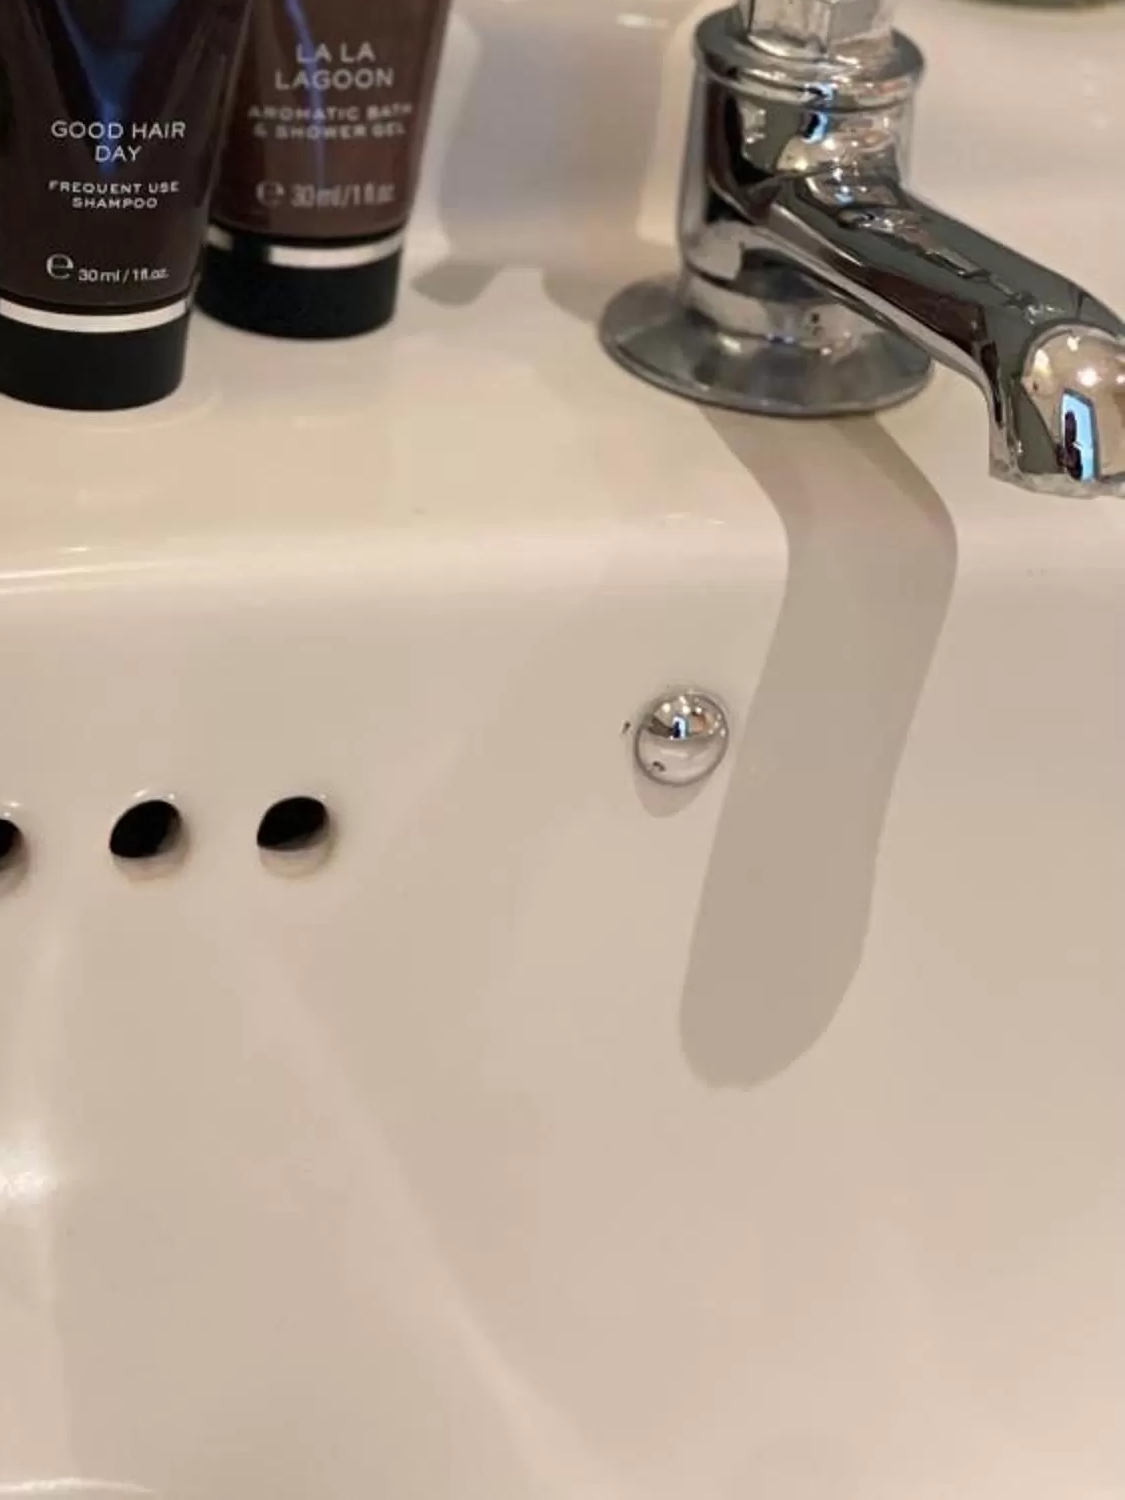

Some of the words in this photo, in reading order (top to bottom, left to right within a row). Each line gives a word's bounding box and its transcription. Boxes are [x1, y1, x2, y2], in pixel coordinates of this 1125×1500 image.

[296, 44, 332, 63] LA
[340, 41, 375, 63] LA
[275, 68, 394, 90] LAGOON
[51, 120, 124, 140] GOOD
[132, 121, 186, 140] HAIR
[95, 145, 142, 163] DAY
[49, 180, 142, 194] FREQUENT
[149, 180, 180, 194] USE
[72, 197, 158, 209] SHAMPOO
